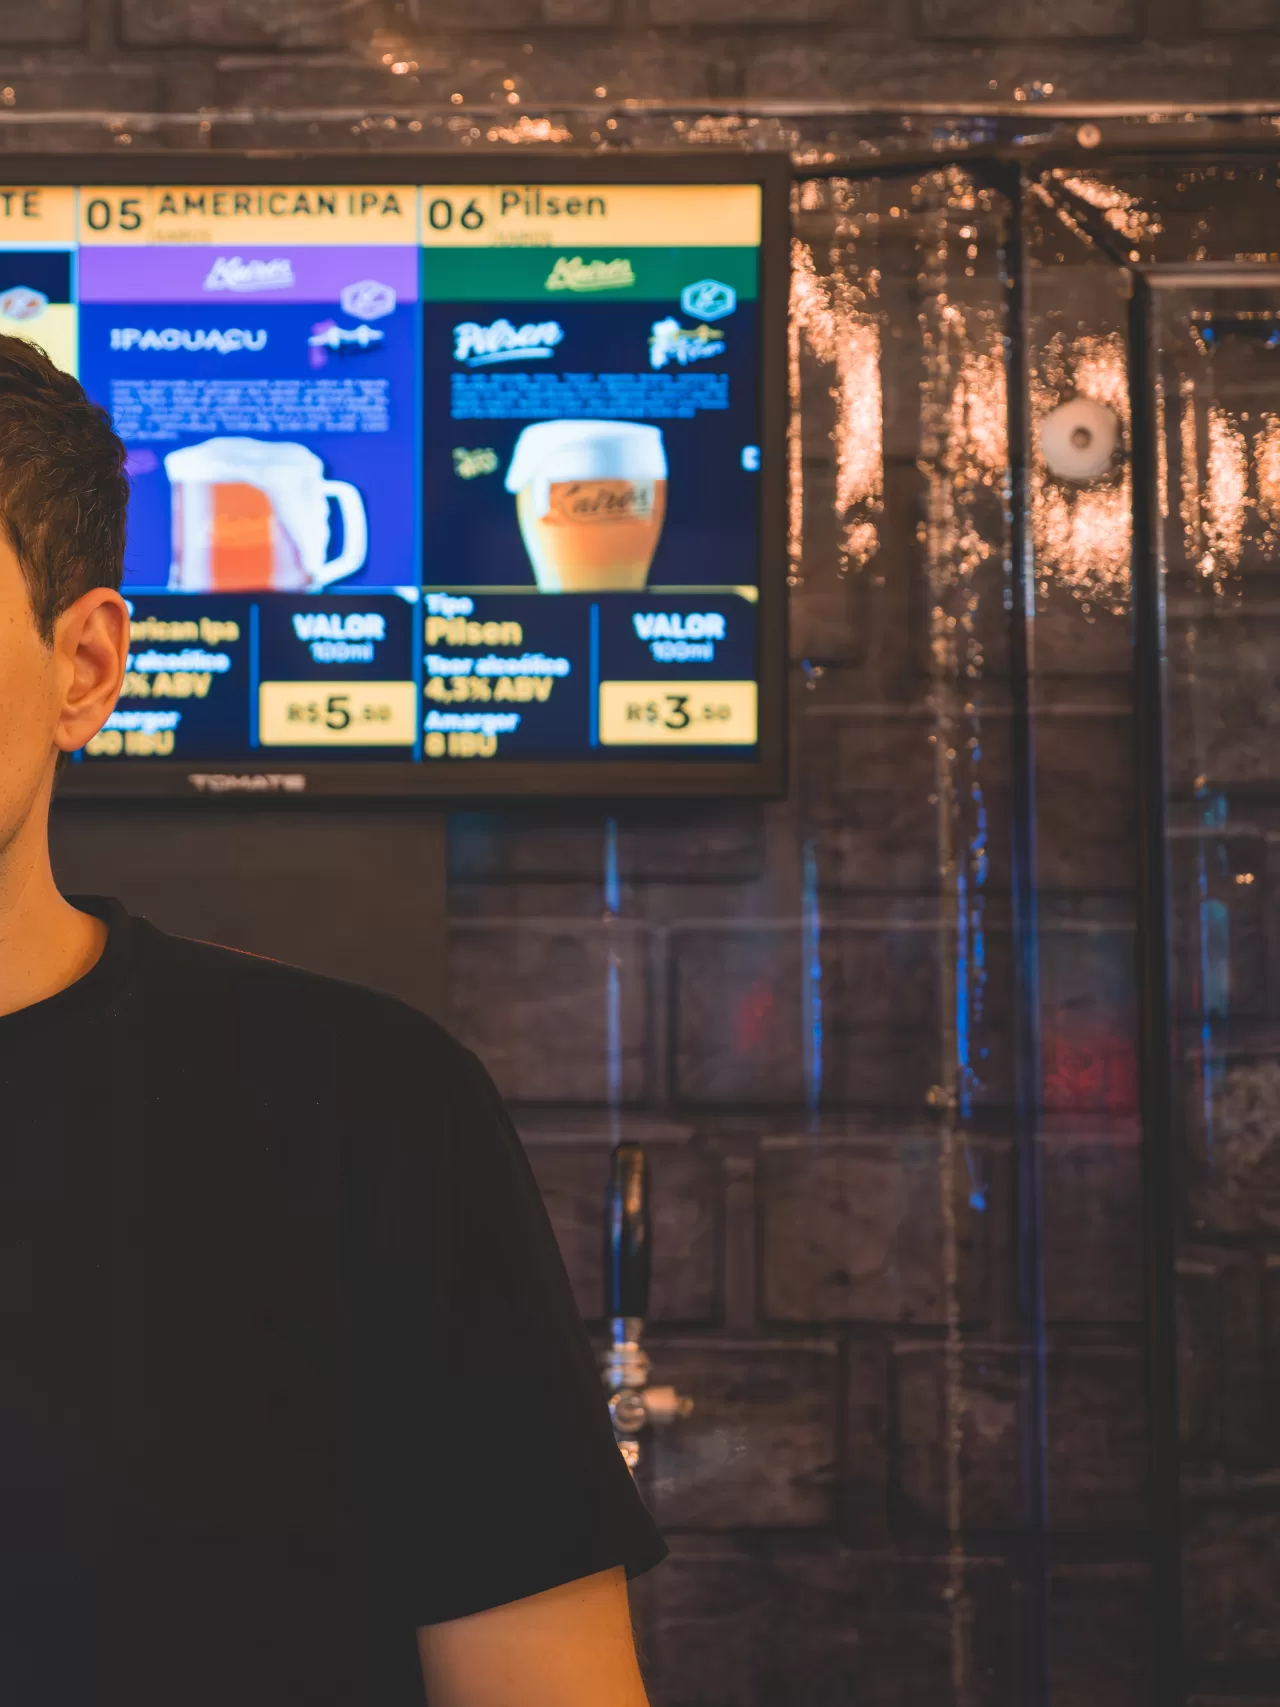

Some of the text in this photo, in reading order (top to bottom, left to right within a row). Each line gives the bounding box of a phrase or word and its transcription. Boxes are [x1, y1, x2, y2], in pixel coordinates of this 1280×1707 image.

[87, 199, 142, 230] 05
[158, 191, 402, 217] AMERICAN IPA
[428, 199, 485, 230] 06
[501, 189, 606, 216] Pilsen
[292, 613, 387, 641] VALOR
[425, 616, 523, 646] Pilsen
[632, 612, 726, 640] VALOR
[152, 672, 212, 698] ABV
[493, 677, 554, 702] ABV
[106, 711, 182, 737] margor
[189, 773, 306, 792] TOMATE
